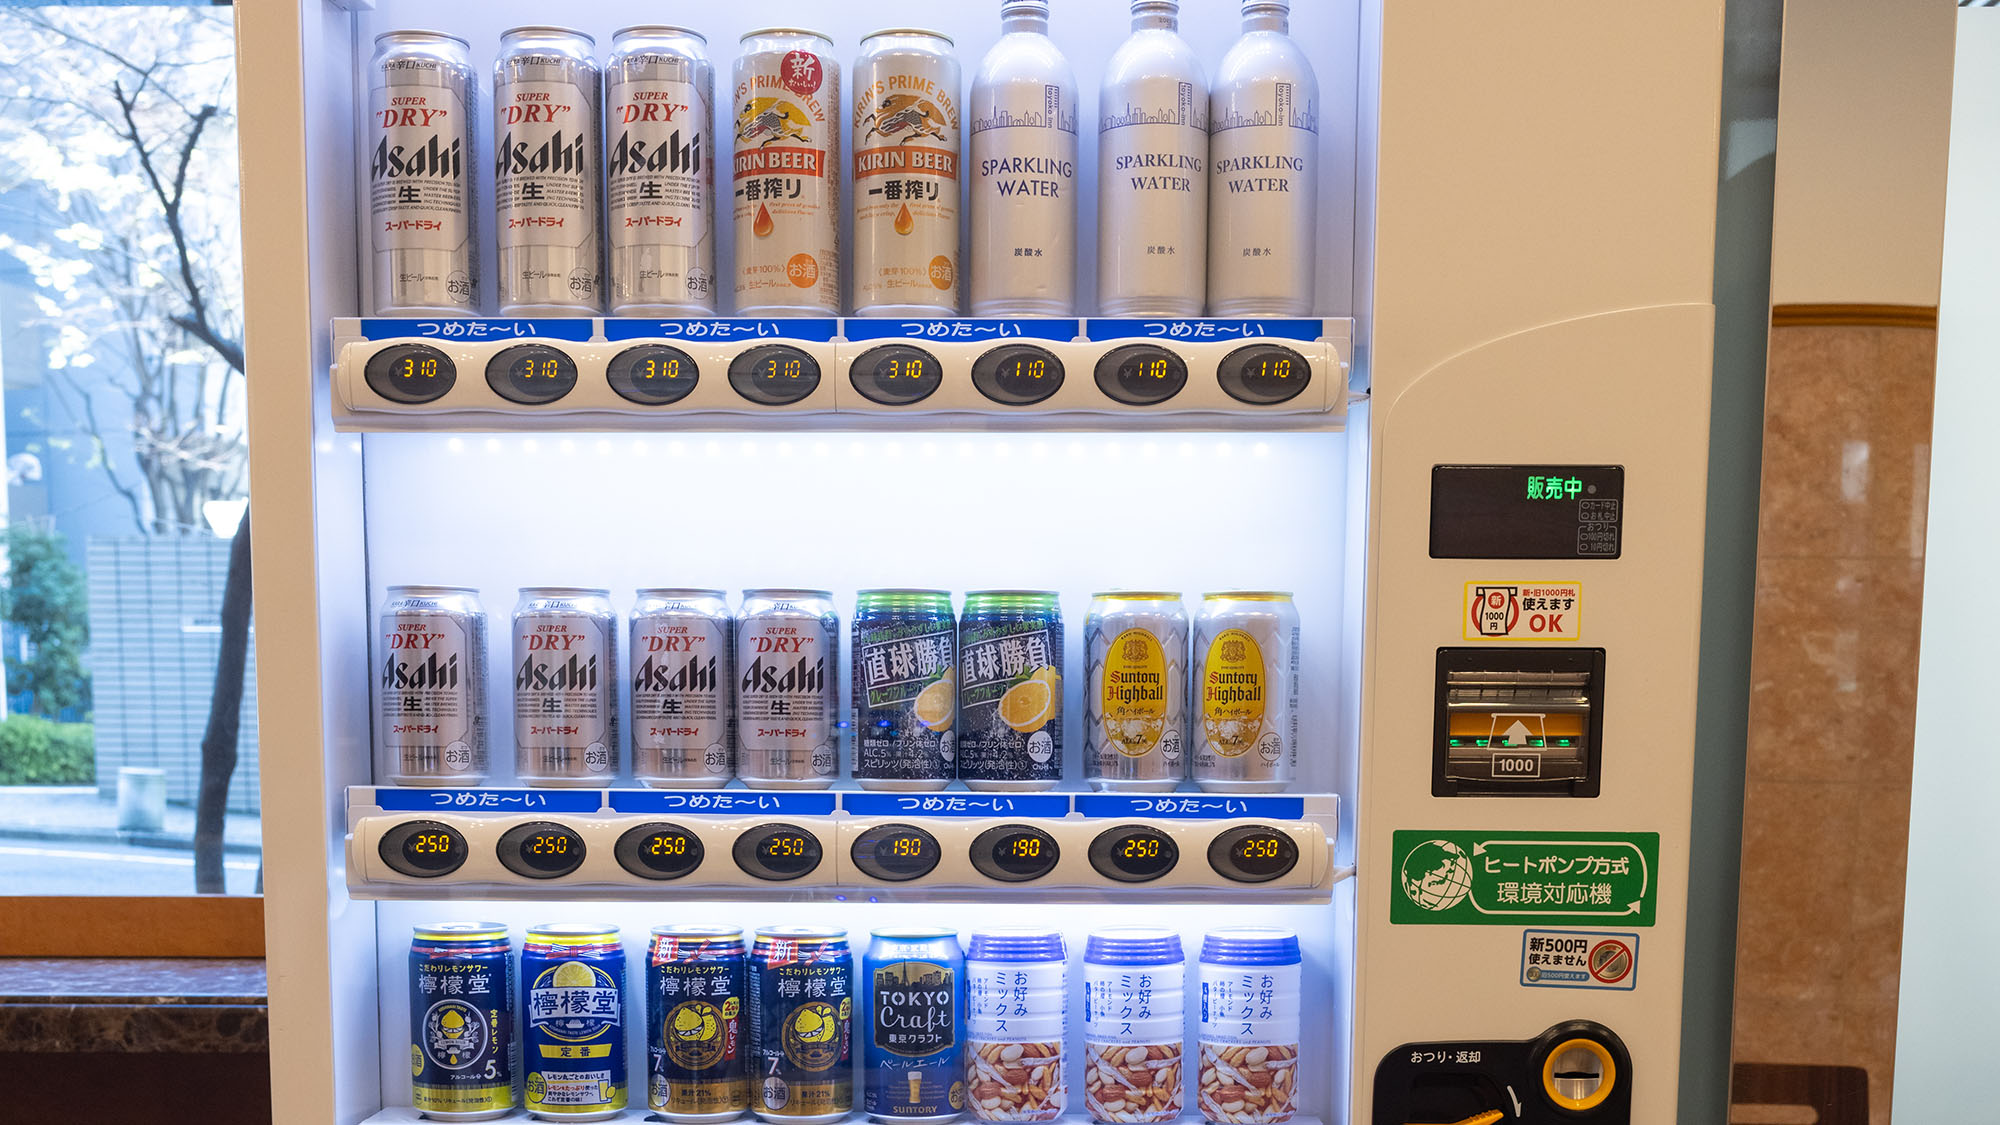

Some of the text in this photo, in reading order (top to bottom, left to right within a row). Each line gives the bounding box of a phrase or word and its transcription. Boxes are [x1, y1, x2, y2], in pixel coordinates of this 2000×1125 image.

[790, 53, 815, 81] 新
[392, 97, 426, 106] SUPER
[516, 93, 550, 102] SUPER
[633, 92, 668, 101] SUPER
[854, 75, 958, 130] KIRIN'S PRIME BREW
[371, 134, 460, 181] Asahi
[496, 130, 583, 178] Asahi
[610, 129, 700, 178] Asahi
[769, 152, 816, 171] BEER
[858, 151, 953, 172] KIRIN BEER
[982, 156, 1072, 178] SPARKLING
[1116, 153, 1202, 172] SPARKLING
[1216, 155, 1303, 175] SPARKLING
[521, 182, 545, 200] 生
[640, 181, 663, 199] 生
[735, 178, 801, 201] 一番搾り
[868, 180, 939, 200] 一番搾り
[997, 180, 1059, 198] WATER
[1131, 176, 1191, 192] WATER
[1229, 178, 1289, 194] WATER
[398, 186, 422, 204] 生
[385, 220, 442, 231] スーパードライ
[508, 216, 564, 229] スーパードライ
[625, 216, 682, 228] スーパードライ
[1014, 248, 1043, 257] 炭酸水
[1147, 246, 1175, 255] 炭酸水
[1242, 247, 1271, 257] 炭酸水
[789, 263, 816, 278] お酒
[931, 265, 951, 281] お酒
[448, 280, 470, 296] お酒
[570, 276, 592, 292] お酒
[687, 277, 708, 292] お酒
[417, 322, 536, 336] つめた〜い
[660, 322, 779, 337] つめた〜い
[902, 322, 1021, 336] つめた〜い
[1144, 322, 1264, 337] つめた〜い
[1526, 476, 1582, 500] 販売中
[1590, 502, 1616, 510] カード中止
[1591, 512, 1615, 520] お札中止
[1587, 522, 1608, 531] おつり
[1589, 532, 1614, 541] 100円切れ
[1591, 543, 1614, 552] 10円切れ
[1522, 589, 1575, 597] 新・旧1000円札
[1490, 596, 1502, 606] 新
[1522, 598, 1575, 611] 使えます
[1485, 612, 1504, 621] 1000
[1529, 613, 1563, 633] OK
[397, 624, 426, 632] SUPER
[657, 626, 688, 634] SUPER
[865, 636, 954, 685] 直球勝負
[961, 636, 1049, 686] 直球勝負
[382, 652, 457, 689] Asahi
[516, 653, 596, 691] Asahi
[635, 655, 716, 692] Asahi
[742, 656, 823, 694] Asahi
[1110, 670, 1160, 686] Suntory
[1209, 671, 1258, 687] Suntory
[1107, 686, 1163, 704] Highball
[1206, 686, 1261, 706] Highball
[403, 697, 422, 712] 生
[542, 697, 563, 713] 生
[662, 699, 683, 714] 生
[770, 700, 791, 715] 生
[1117, 706, 1155, 716] 角ハイボール
[1214, 706, 1252, 716] 角ハイボール
[393, 725, 438, 734] スーパードライ
[530, 726, 579, 734] スーパードライ
[650, 728, 699, 736] スーパードライ
[758, 729, 806, 737] スーパードライ
[1029, 741, 1051, 754] お酒
[1163, 739, 1179, 753] お酒
[1261, 742, 1280, 754] お酒
[446, 749, 470, 763] お酒
[585, 749, 607, 765] お酒
[705, 752, 726, 766] お酒
[812, 753, 831, 767] お酒
[1500, 758, 1534, 771] 1000
[431, 793, 545, 807] つめた〜い
[664, 794, 780, 809] つめた〜い
[898, 796, 1014, 812] つめた〜い
[1131, 798, 1246, 813] つめた〜い
[1484, 856, 1629, 876] ヒートポンプ方式
[1497, 882, 1612, 905] 環境対応機
[658, 938, 674, 959] 新
[774, 940, 792, 962] 新
[1530, 937, 1588, 953] 新500円
[1529, 954, 1587, 966] 使えません
[419, 964, 488, 972] こだわりレモンサワー
[661, 966, 729, 974] こだわりレモンサワー
[780, 967, 845, 975] こだわりレモンサワー
[418, 974, 490, 995] 檸檬堂
[659, 976, 731, 996] 檸檬堂
[778, 977, 845, 998] 檸檬堂
[880, 991, 949, 1006] TOKYO
[1014, 971, 1027, 1016] お好み
[1139, 974, 1152, 1019] お好み
[1260, 974, 1273, 1020] お好み
[534, 990, 615, 1016] 檸檬堂
[996, 972, 1008, 1032] ミックス
[1120, 975, 1133, 1035] ミックス
[1241, 975, 1254, 1035] ミックス
[880, 1006, 950, 1032] Craft
[490, 1009, 499, 1054] 定番レモン
[728, 1020, 738, 1054] 鬼レモン
[889, 1034, 942, 1043] 東京クラフト
[560, 1047, 590, 1056] 定番
[1410, 1051, 1481, 1064] おつり・返却
[880, 1057, 950, 1070] ペールエール
[528, 1080, 544, 1094] お酒
[652, 1084, 667, 1097] お酒
[764, 1087, 786, 1099] お酒
